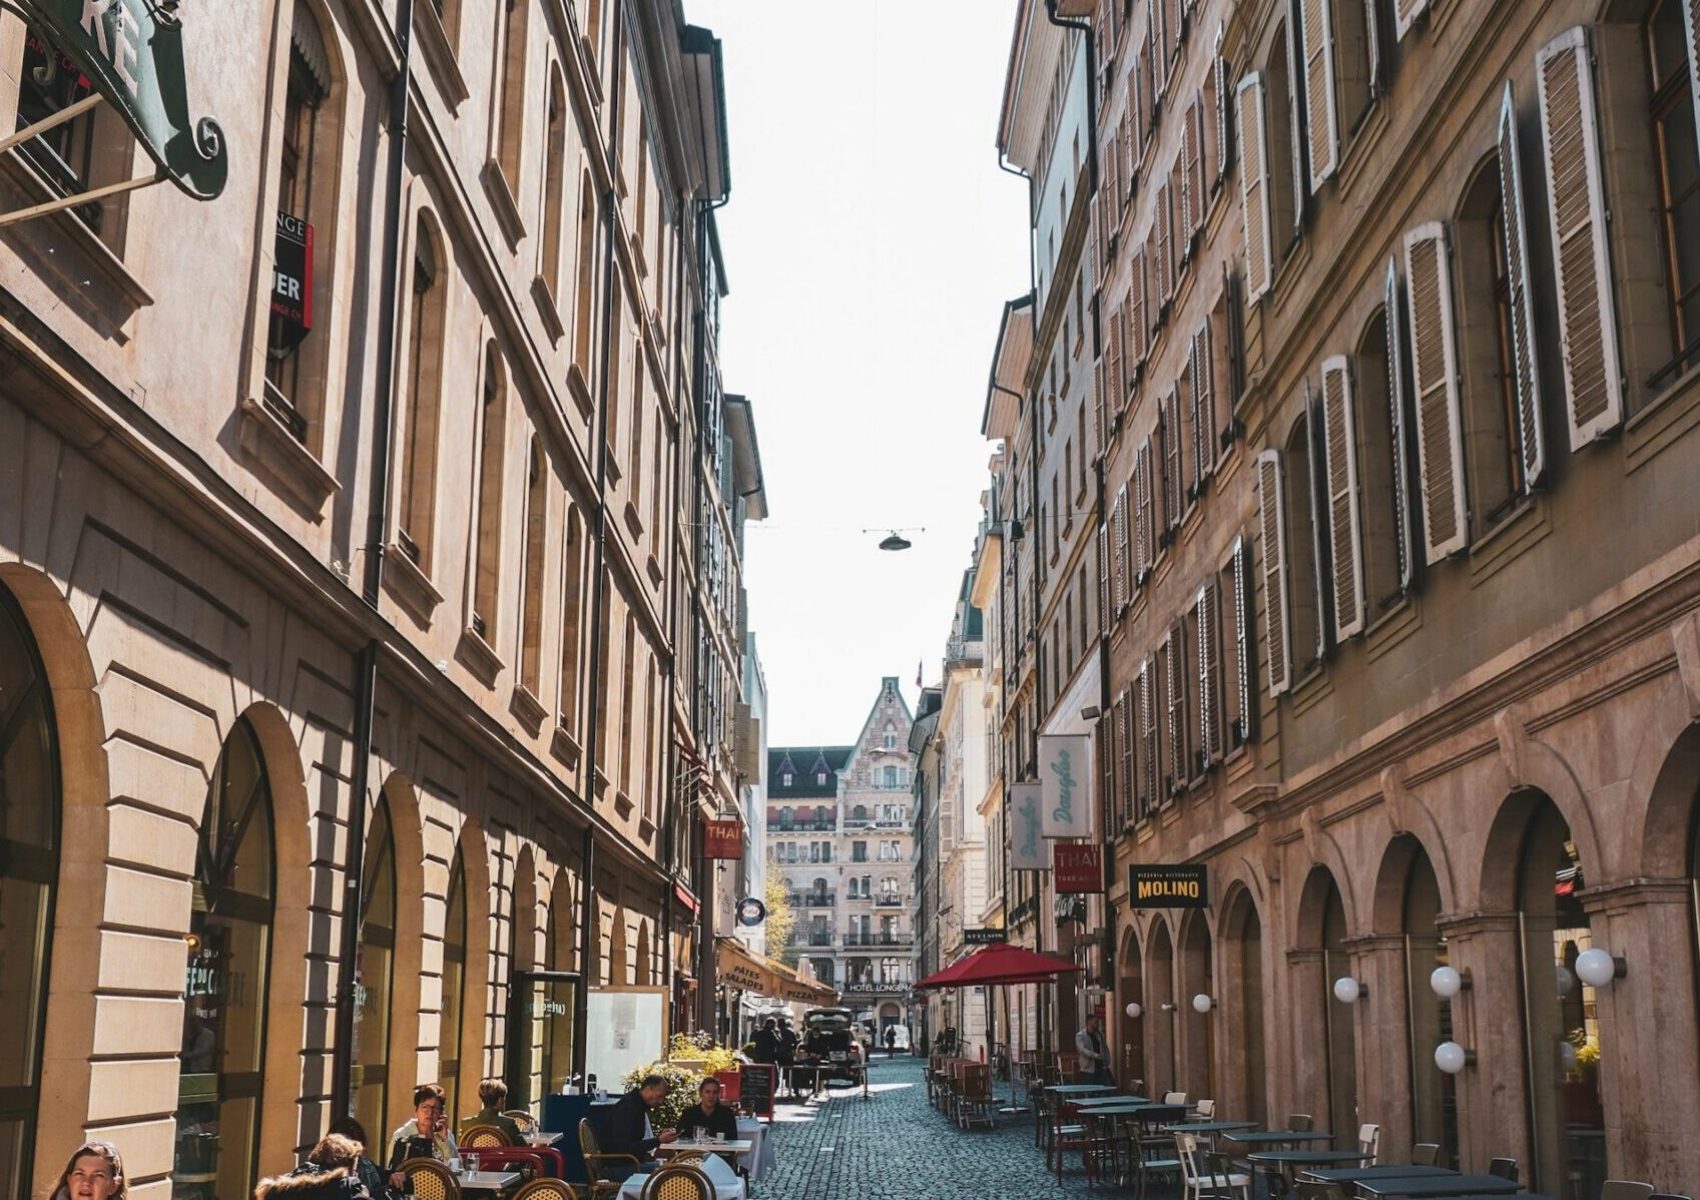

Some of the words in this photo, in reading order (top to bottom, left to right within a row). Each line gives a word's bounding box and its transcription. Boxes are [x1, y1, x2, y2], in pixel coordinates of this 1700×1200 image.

[707, 826, 740, 840] THAI
[1057, 851, 1097, 869] THAI
[1138, 880, 1200, 899] MOLINO
[733, 965, 760, 980] PÂTES
[724, 972, 765, 991] SALADES
[849, 983, 874, 992] HOTEL
[786, 989, 818, 1001] PIZZAS
